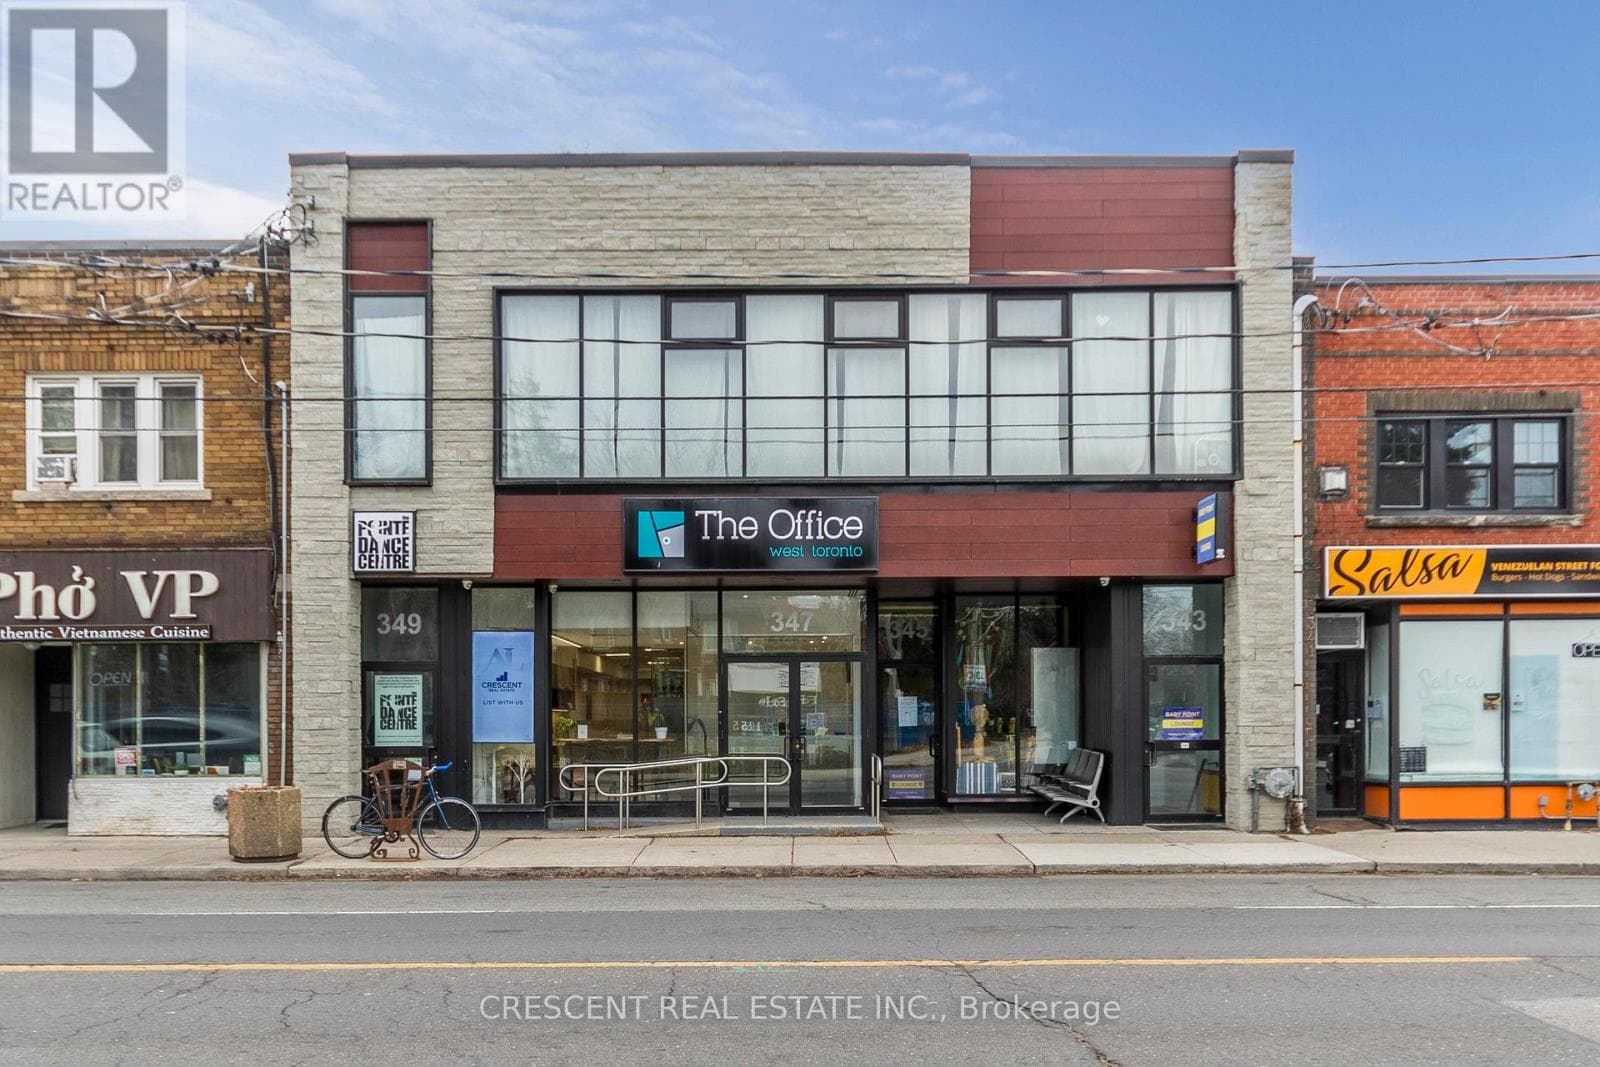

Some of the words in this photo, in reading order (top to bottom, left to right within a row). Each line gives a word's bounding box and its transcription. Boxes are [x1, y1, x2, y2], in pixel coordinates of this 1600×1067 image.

[695, 510, 759, 540] The
[768, 508, 863, 540] Office
[358, 537, 409, 554] DANCE
[770, 545, 805, 557] west
[811, 545, 863, 557] toronto
[358, 554, 409, 569] CENTRE
[1491, 562, 1554, 571] VENEZUELAN
[1555, 562, 1588, 571] STREET
[1328, 549, 1473, 595] Salsa
[1491, 573, 1522, 582] Burgers
[120, 570, 220, 619] VP
[376, 613, 422, 635] 349
[770, 613, 814, 632] 347
[58, 626, 145, 638] Vietnamese
[151, 625, 209, 638] Cuisine
[90, 672, 132, 687] OPEN
[380, 707, 417, 719] DANCE
